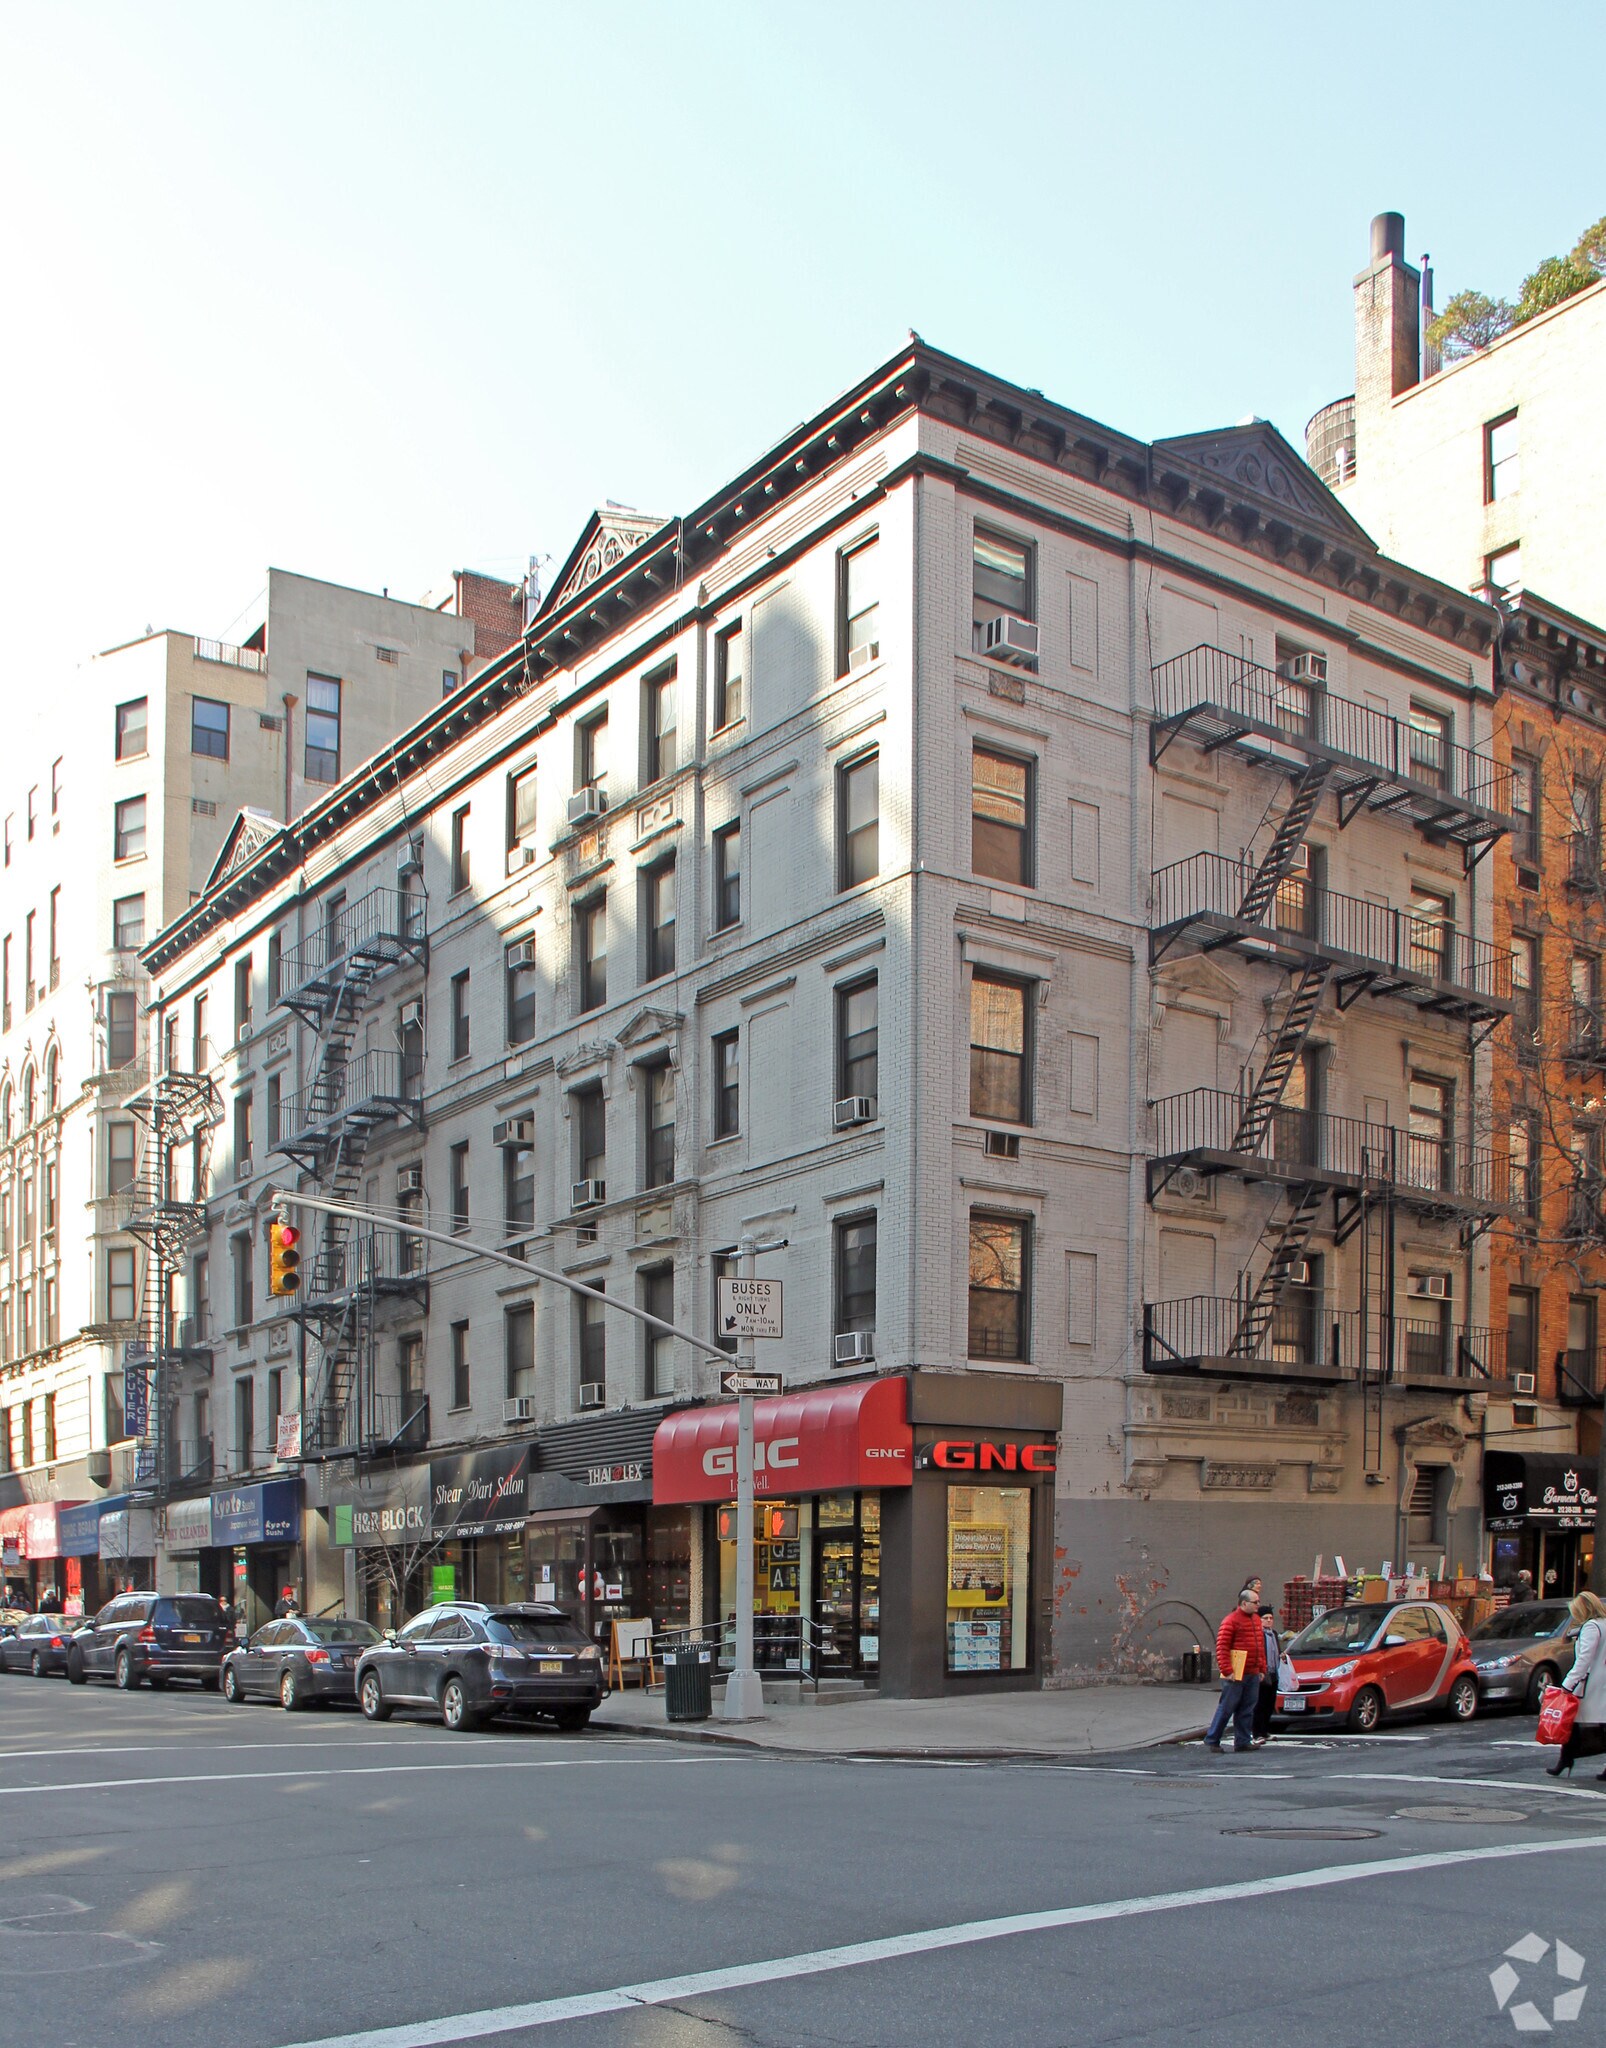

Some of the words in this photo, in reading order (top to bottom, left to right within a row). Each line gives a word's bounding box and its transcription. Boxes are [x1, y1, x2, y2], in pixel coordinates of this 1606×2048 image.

[732, 1283, 771, 1295] BUSES
[736, 1303, 767, 1315] ONLY
[741, 1325, 755, 1333] MON
[769, 1326, 779, 1334] FRI
[729, 1378, 748, 1388] ONE
[755, 1379, 775, 1389] WAY
[865, 1448, 905, 1458] GNC
[933, 1440, 1057, 1471] GNC
[436, 1484, 463, 1505] Shear
[496, 1474, 524, 1497] Salon
[1543, 1486, 1579, 1504] Garment
[1579, 1488, 1598, 1504] Car
[242, 1499, 256, 1511] Sushi
[353, 1511, 379, 1533] H&R
[381, 1506, 424, 1531] BLOCK
[180, 1524, 209, 1539] CLEANERS
[457, 1527, 469, 1536] OPEN
[473, 1526, 484, 1534] DAYS
[955, 1534, 988, 1542] Unbeatable
[989, 1534, 1003, 1542] Low
[955, 1542, 973, 1550] Prices
[974, 1543, 990, 1551] Every
[990, 1543, 1001, 1551] Day
[773, 1568, 784, 1588] A
